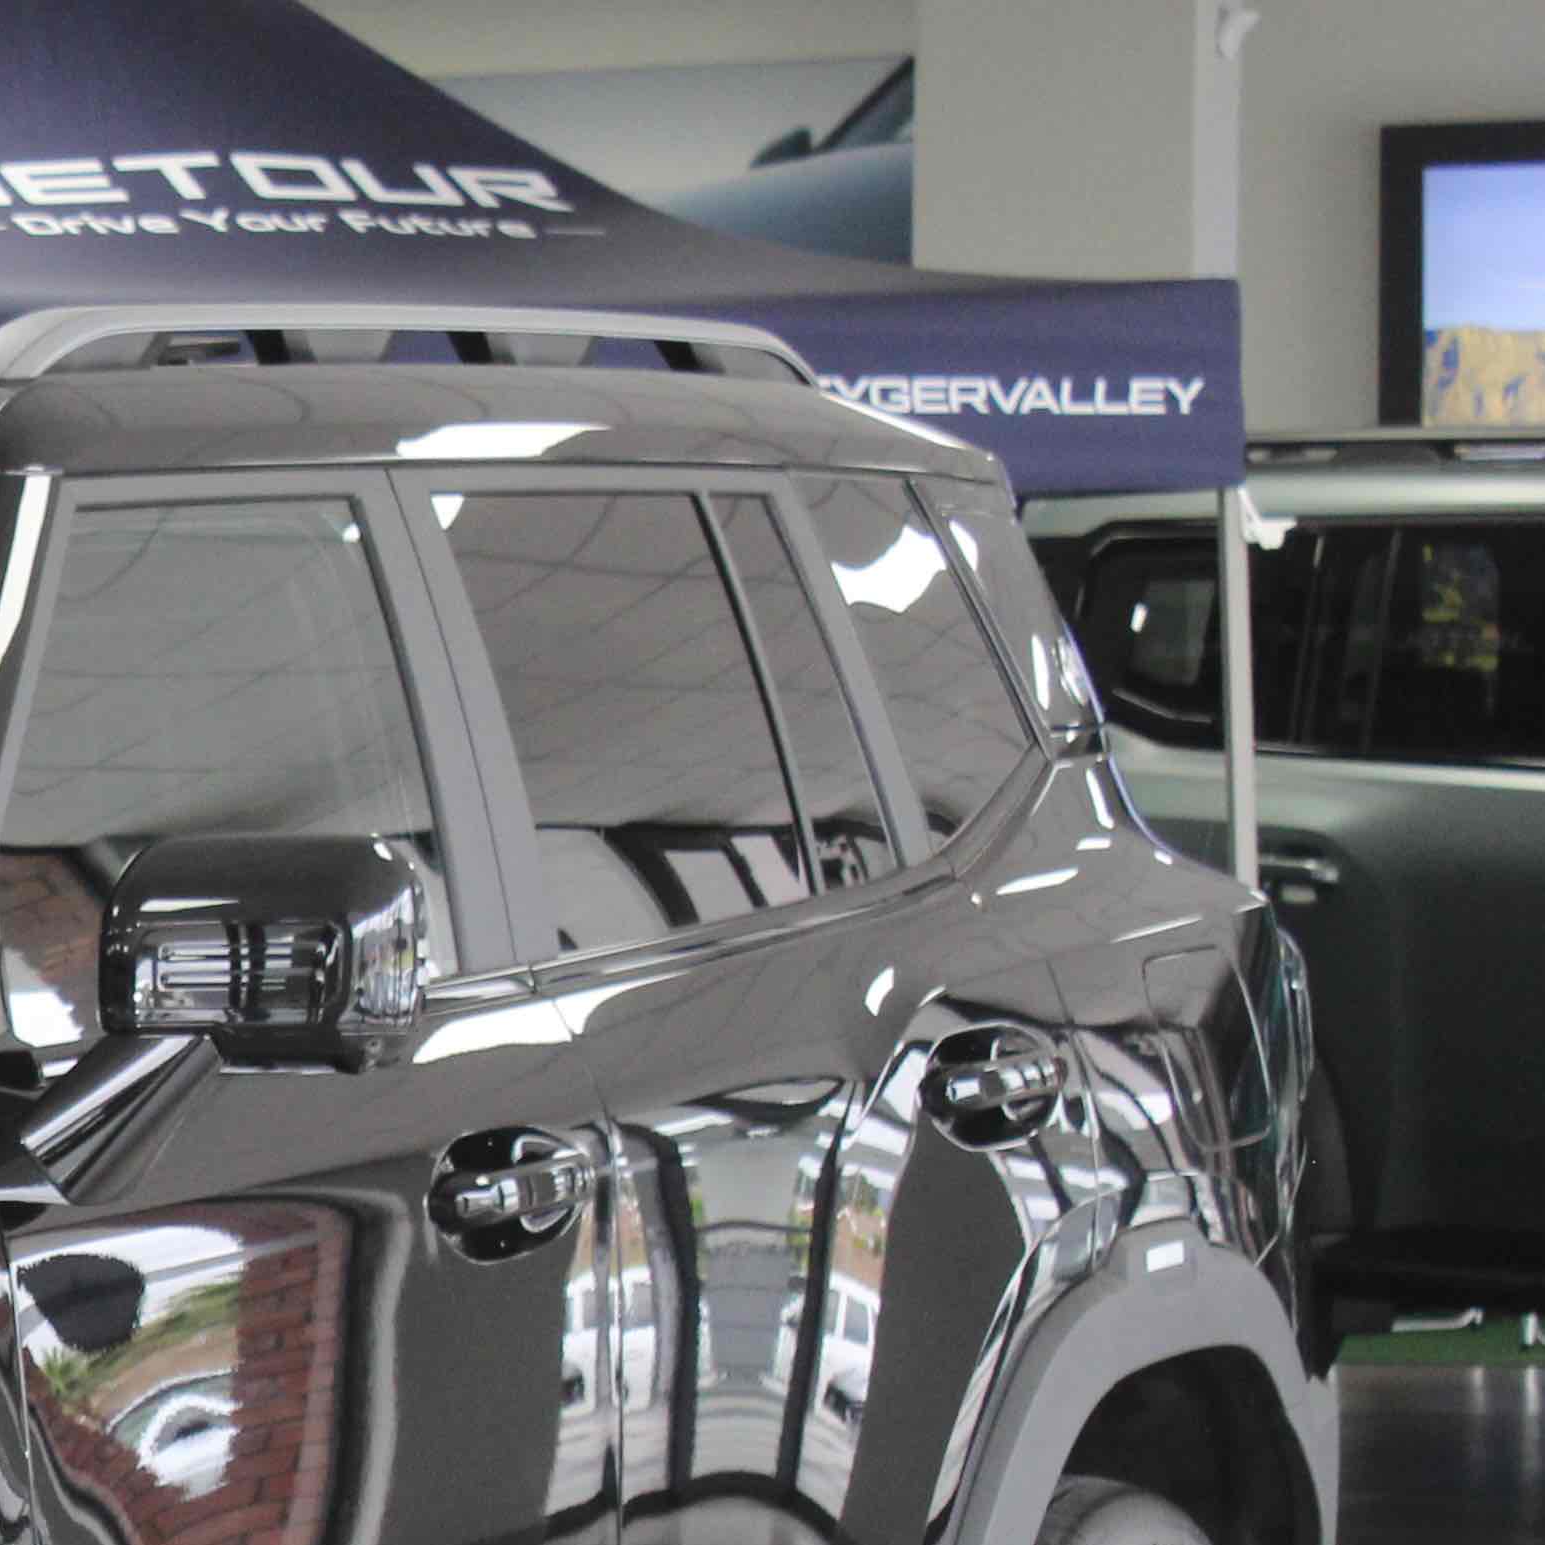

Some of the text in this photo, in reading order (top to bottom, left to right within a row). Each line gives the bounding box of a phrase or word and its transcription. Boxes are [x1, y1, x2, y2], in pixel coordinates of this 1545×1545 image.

[8, 207, 537, 239] Drive Your Future
